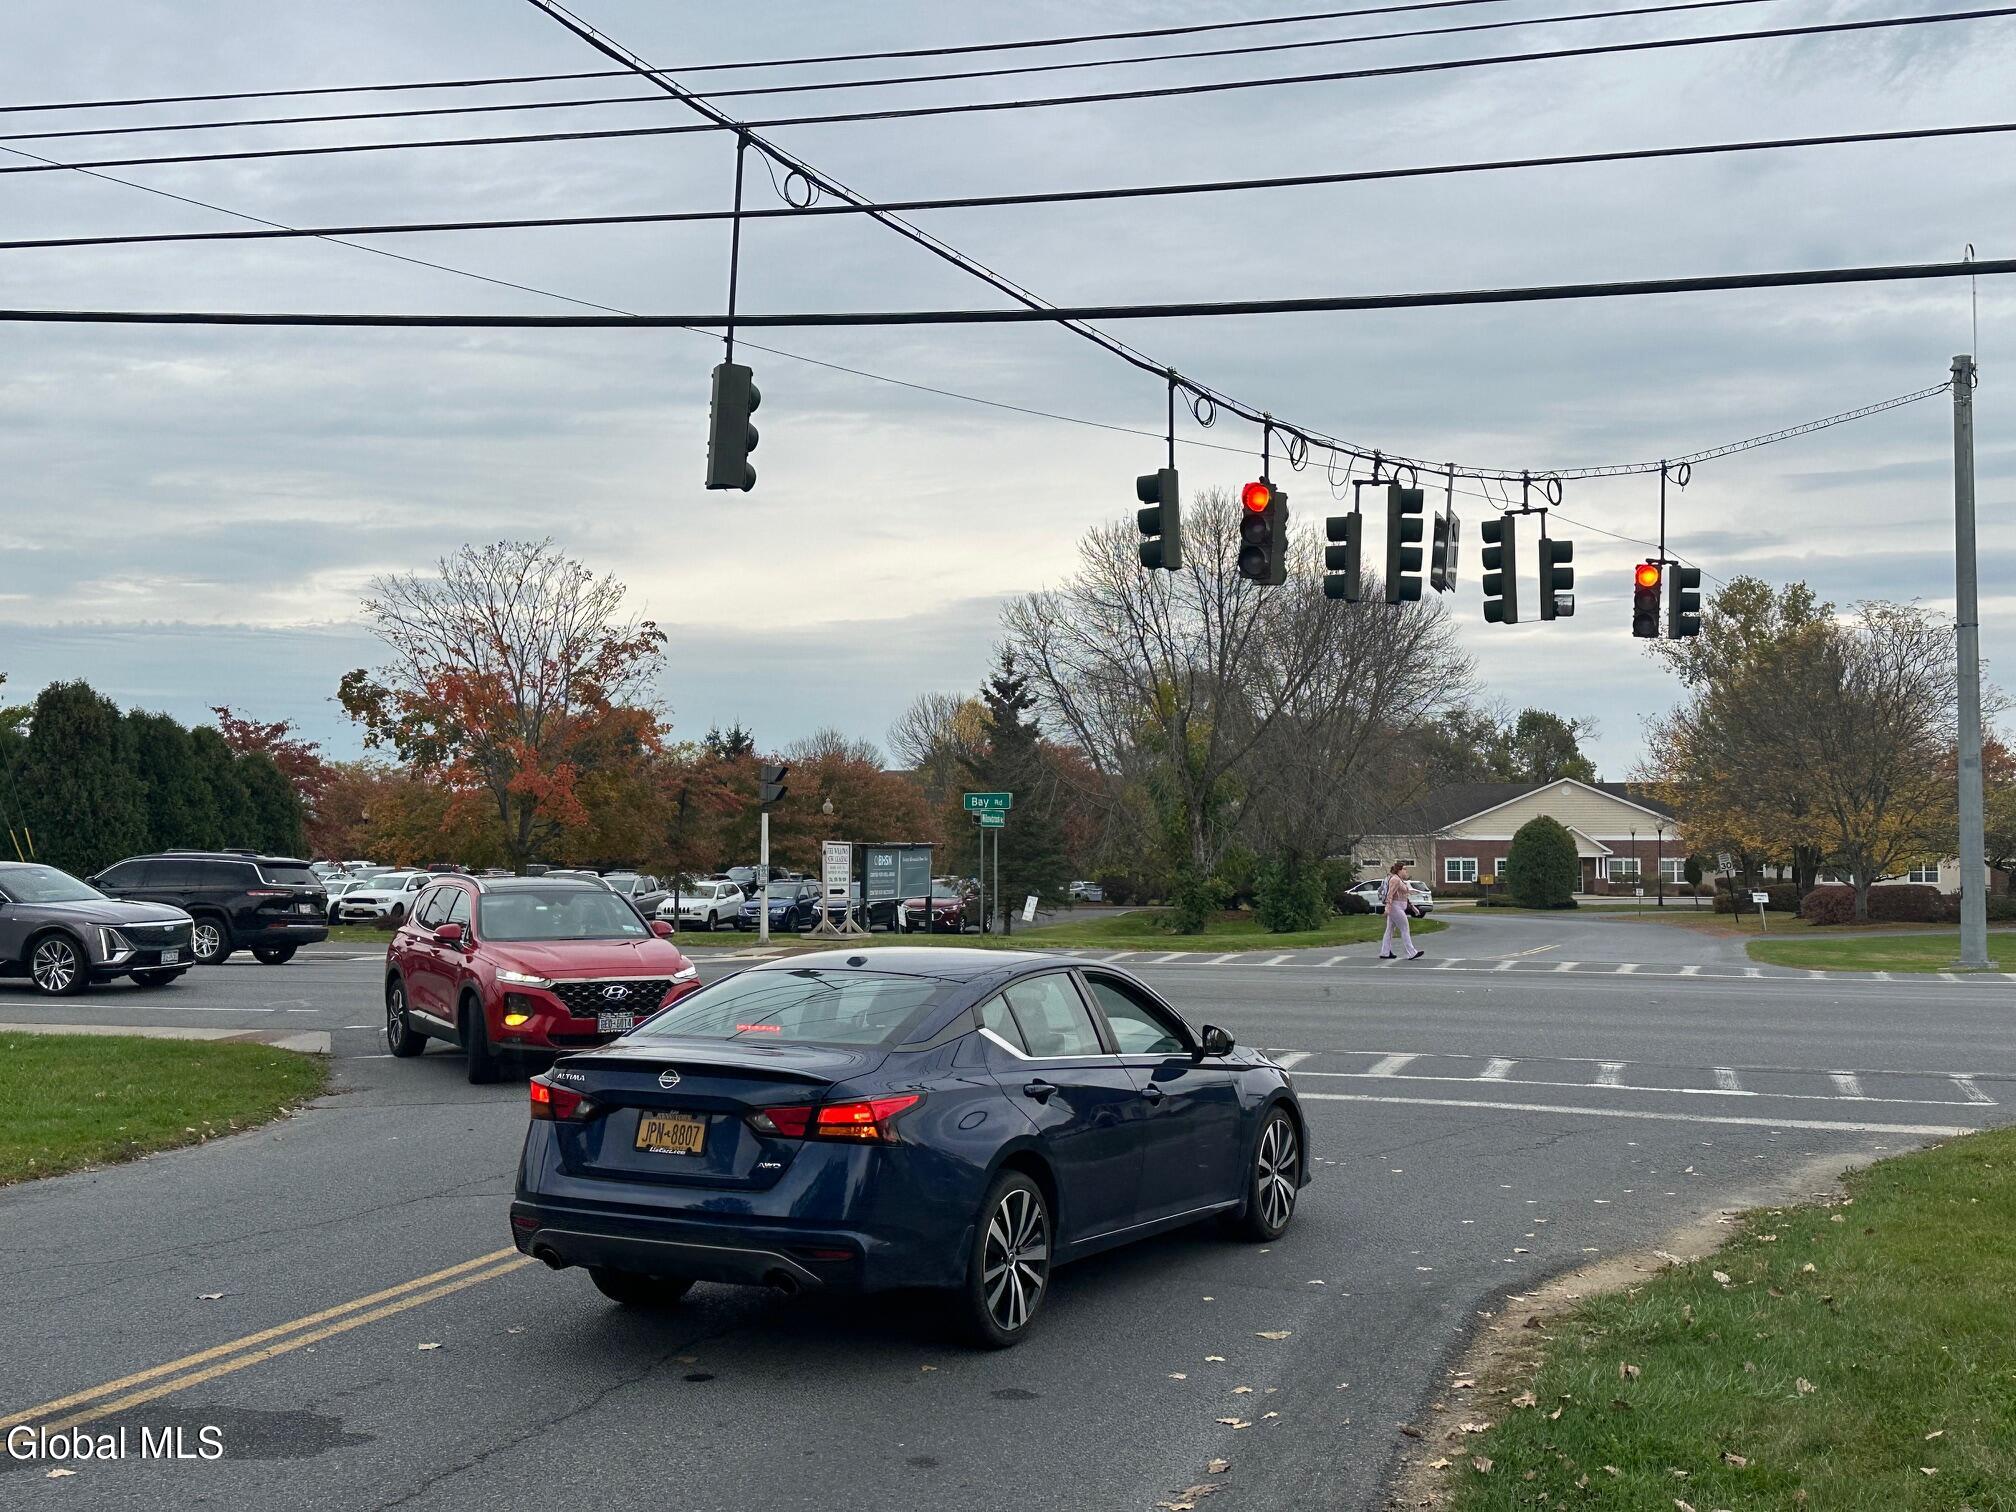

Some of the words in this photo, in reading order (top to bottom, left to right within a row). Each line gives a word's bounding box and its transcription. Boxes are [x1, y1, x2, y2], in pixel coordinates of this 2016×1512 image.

[971, 797, 989, 808] Bay
[1721, 862, 1732, 870] 30
[556, 1073, 585, 1081] ALTIMA
